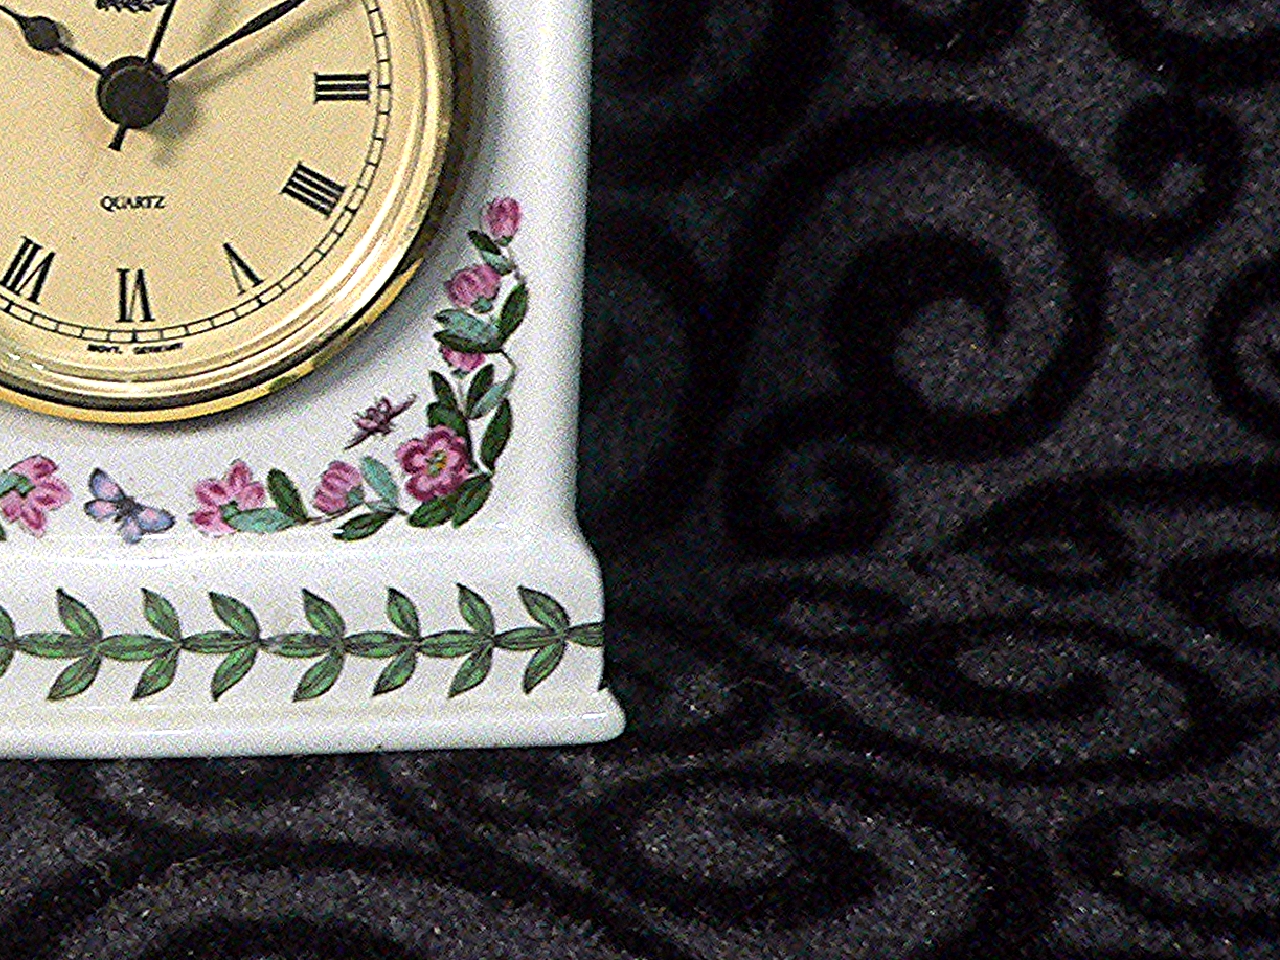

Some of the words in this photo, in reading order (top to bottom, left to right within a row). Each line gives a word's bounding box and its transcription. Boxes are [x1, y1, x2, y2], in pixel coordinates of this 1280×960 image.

[313, 71, 371, 103] III
[100, 195, 166, 211] QUARTZ
[223, 243, 264, 295] V
[116, 267, 156, 323] VI
